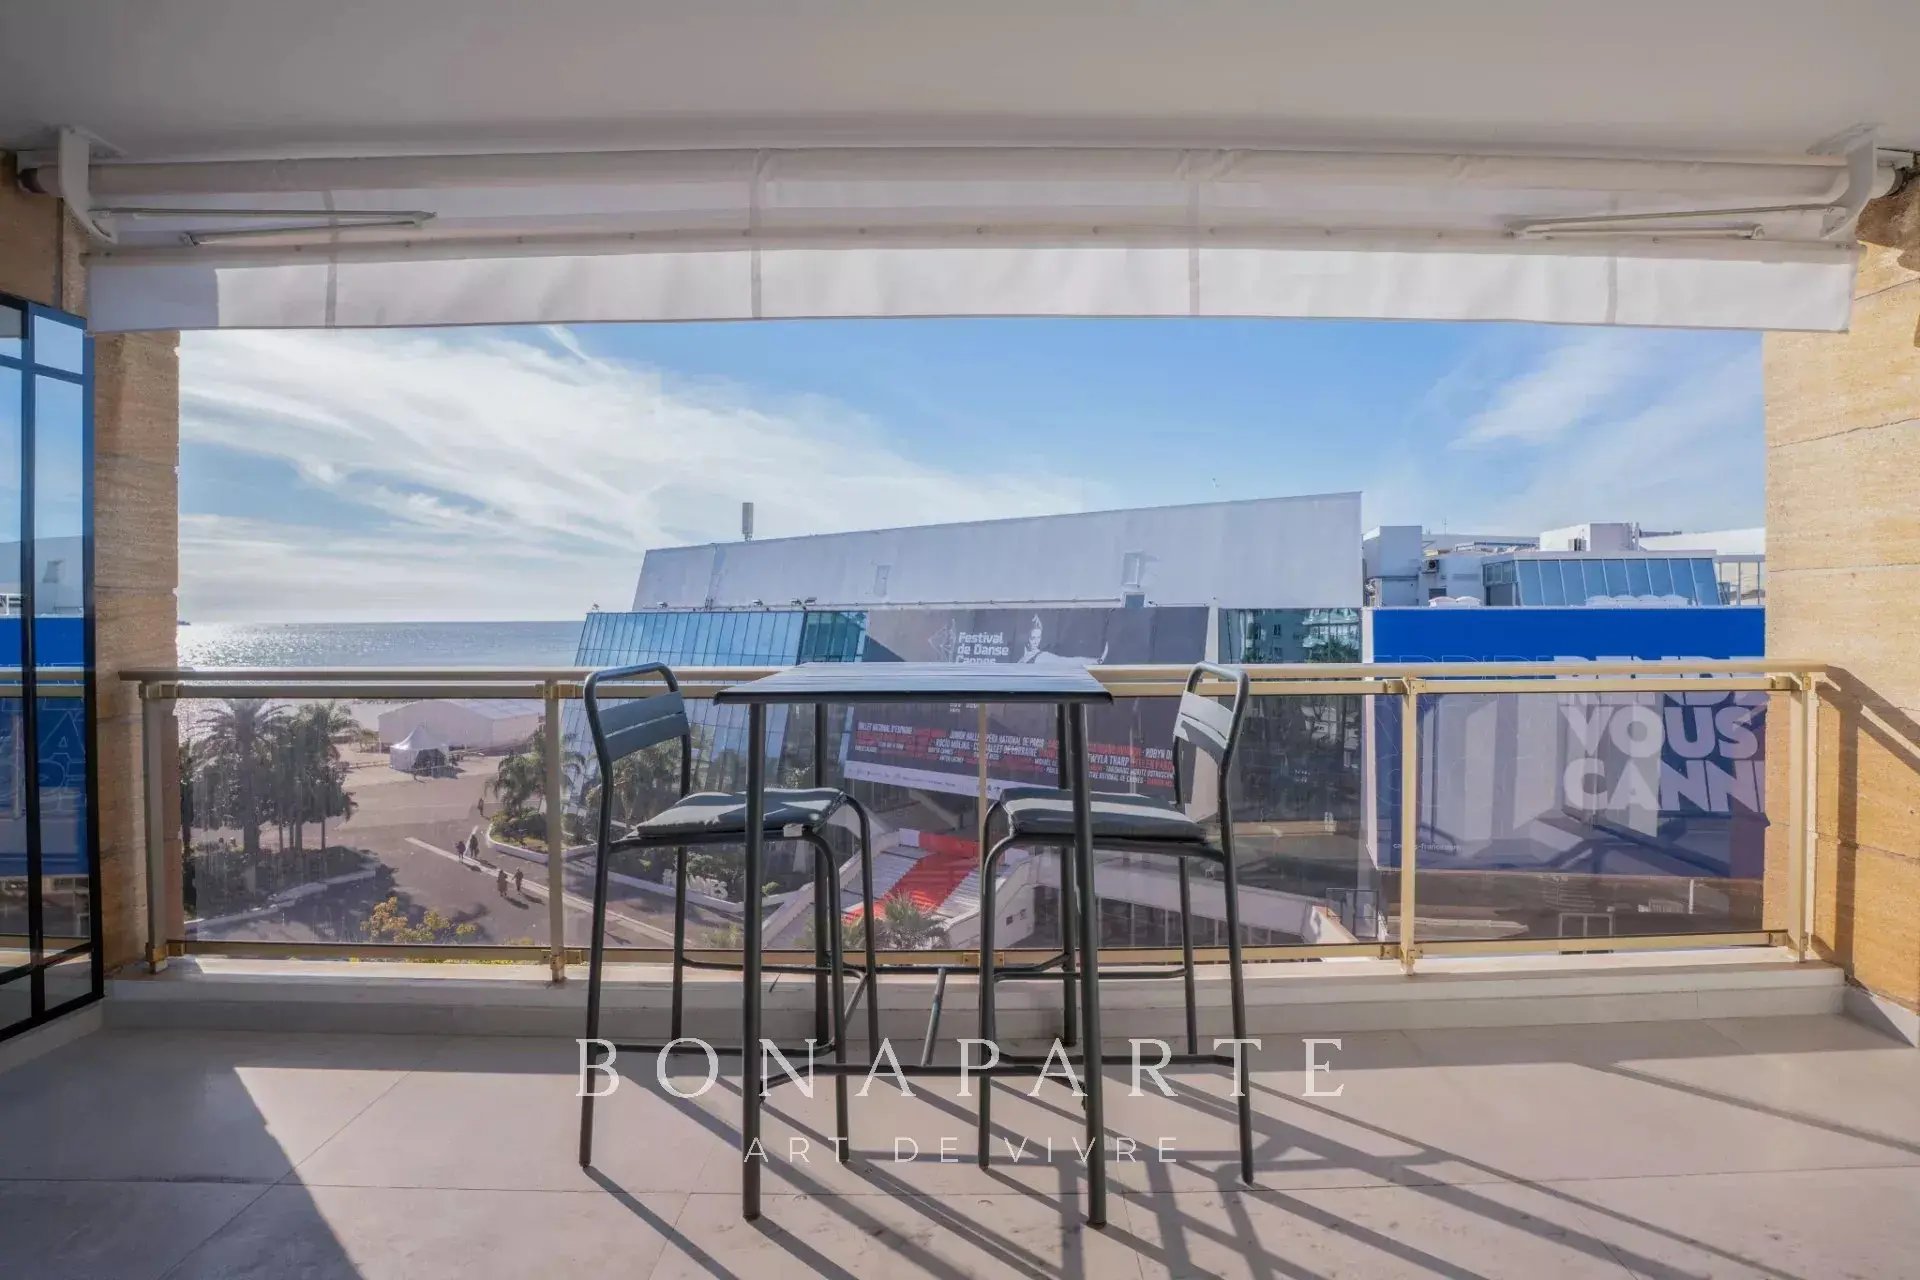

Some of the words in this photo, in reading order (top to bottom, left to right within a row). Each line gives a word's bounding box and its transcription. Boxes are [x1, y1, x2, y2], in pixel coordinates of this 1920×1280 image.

[957, 643, 971, 655] de
[973, 643, 1009, 656] Danse
[958, 632, 1004, 644] Festival
[1560, 705, 1758, 759] VOUS
[1563, 757, 1766, 812] CANN
